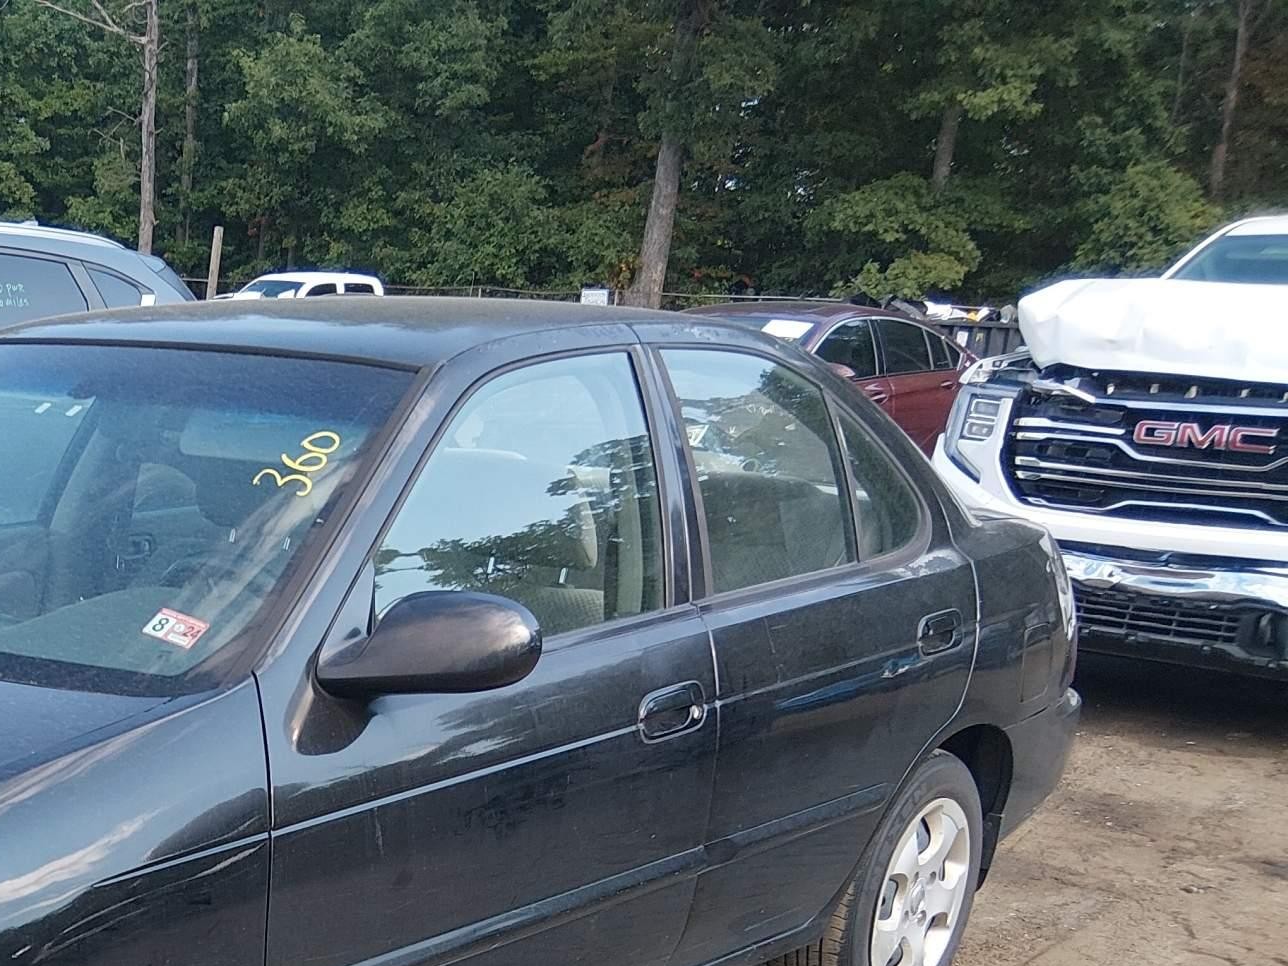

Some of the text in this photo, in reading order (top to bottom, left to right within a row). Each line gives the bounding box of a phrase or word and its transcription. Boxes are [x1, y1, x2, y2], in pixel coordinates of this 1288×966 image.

[1133, 420, 1280, 455] GMC
[252, 431, 341, 497] 360
[151, 617, 170, 632] 8
